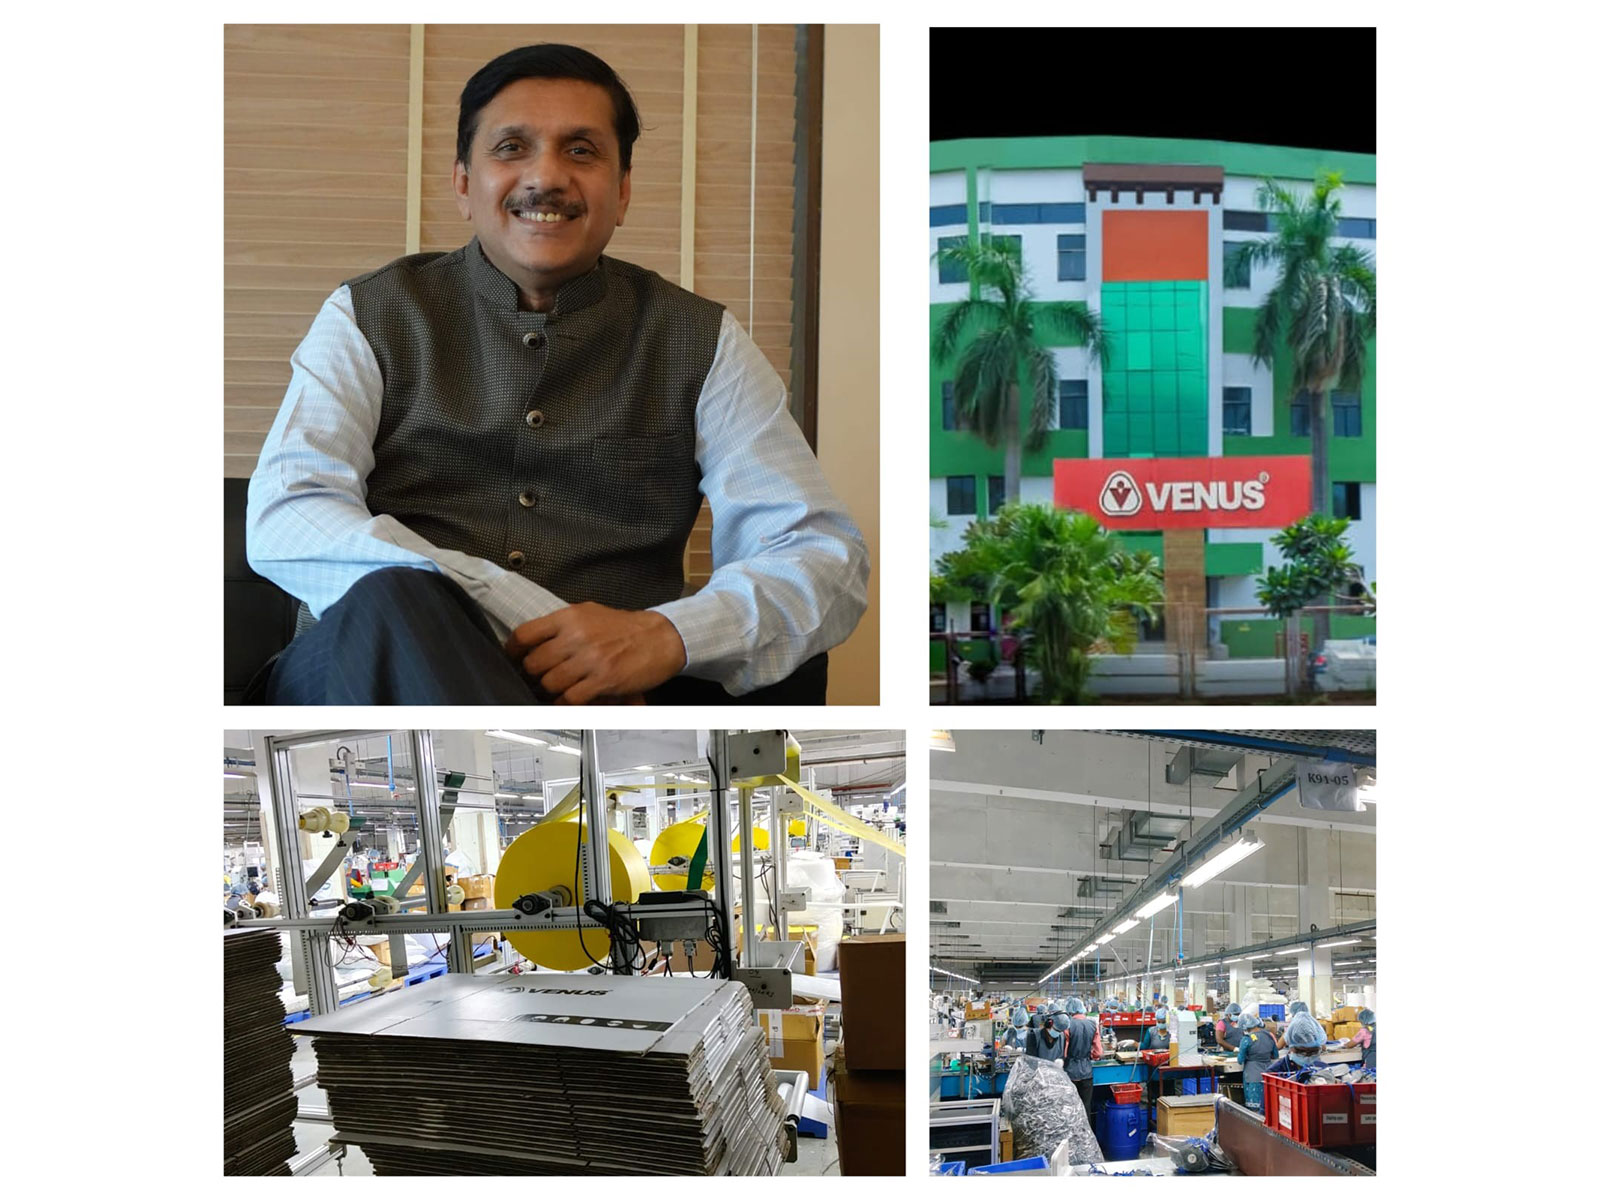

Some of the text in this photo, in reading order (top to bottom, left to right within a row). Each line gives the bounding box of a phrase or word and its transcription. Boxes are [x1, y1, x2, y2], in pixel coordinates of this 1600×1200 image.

[1145, 480, 1265, 512] VENUS
[1307, 772, 1349, 786] K91-05
[528, 988, 609, 996] VENUS
